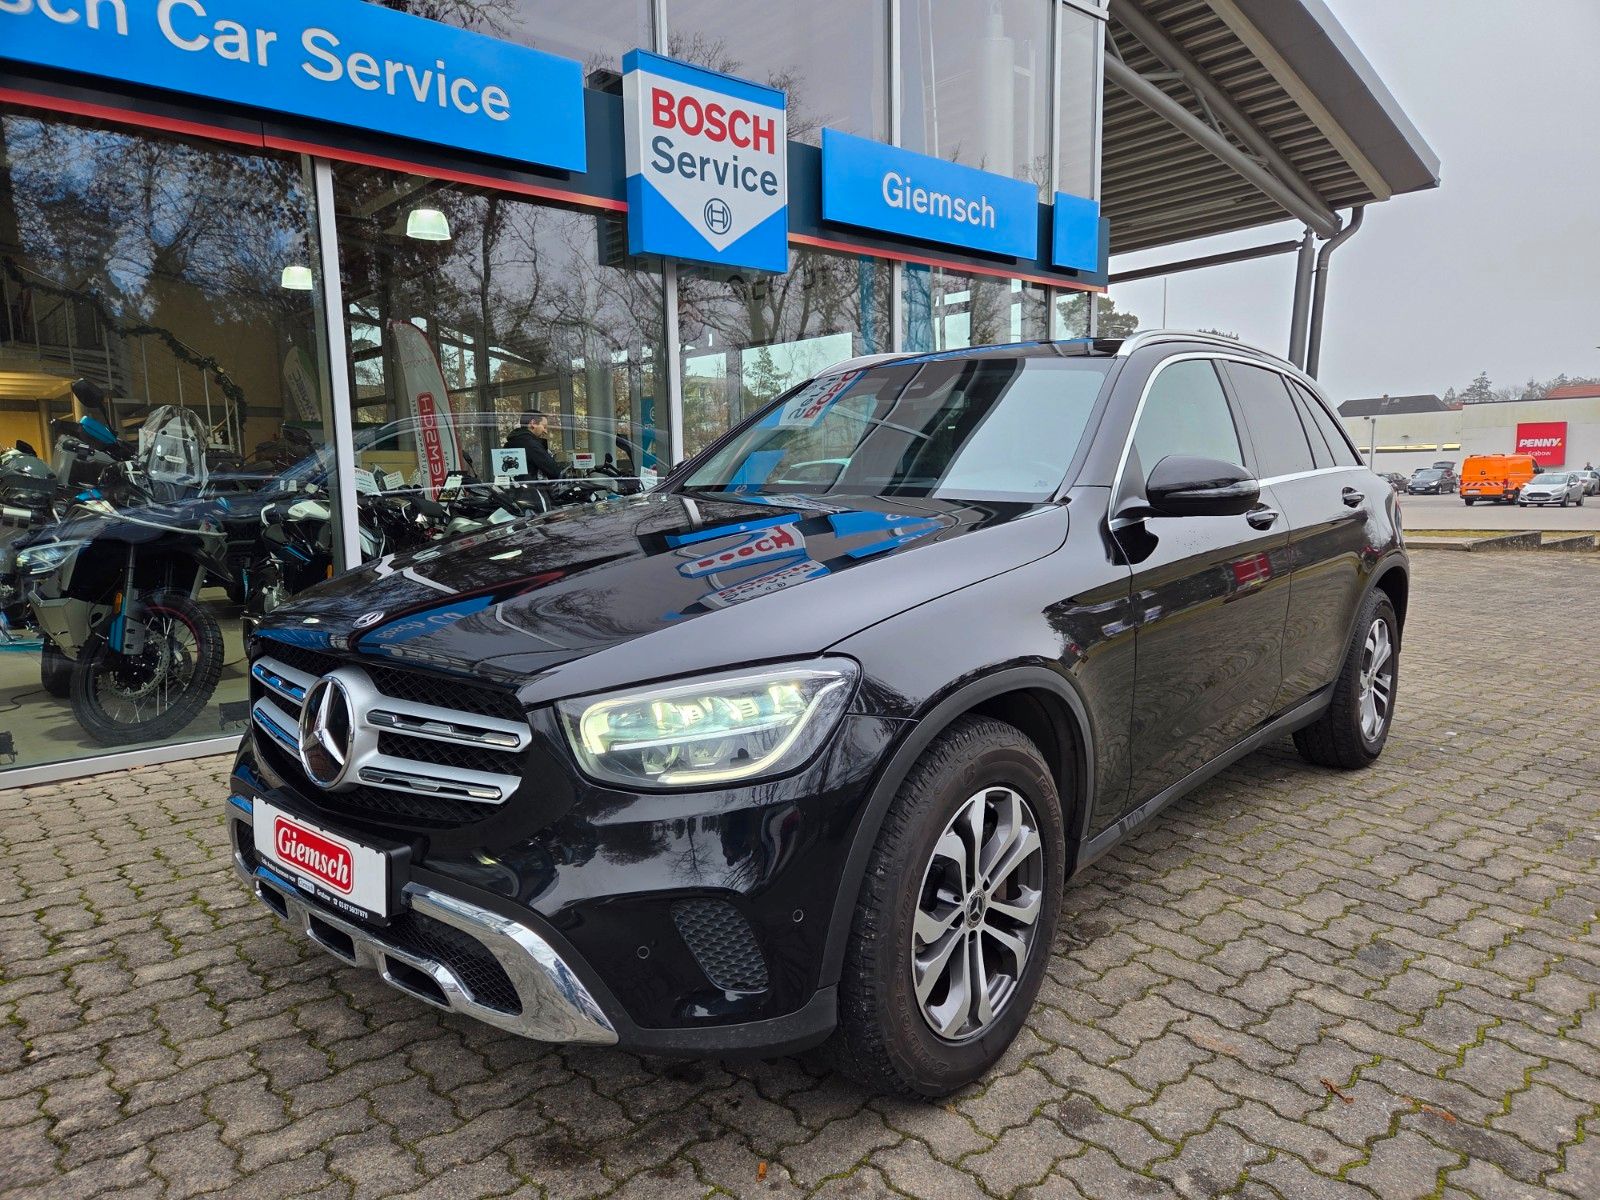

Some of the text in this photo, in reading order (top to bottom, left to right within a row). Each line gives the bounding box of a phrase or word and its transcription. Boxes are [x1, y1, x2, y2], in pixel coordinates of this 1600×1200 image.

[157, 0, 277, 67] Car
[301, 27, 511, 121] Service
[651, 87, 775, 155] BOSCH
[651, 136, 778, 196] Service
[882, 172, 996, 229] Giemsch
[277, 826, 349, 884] Giemsch
